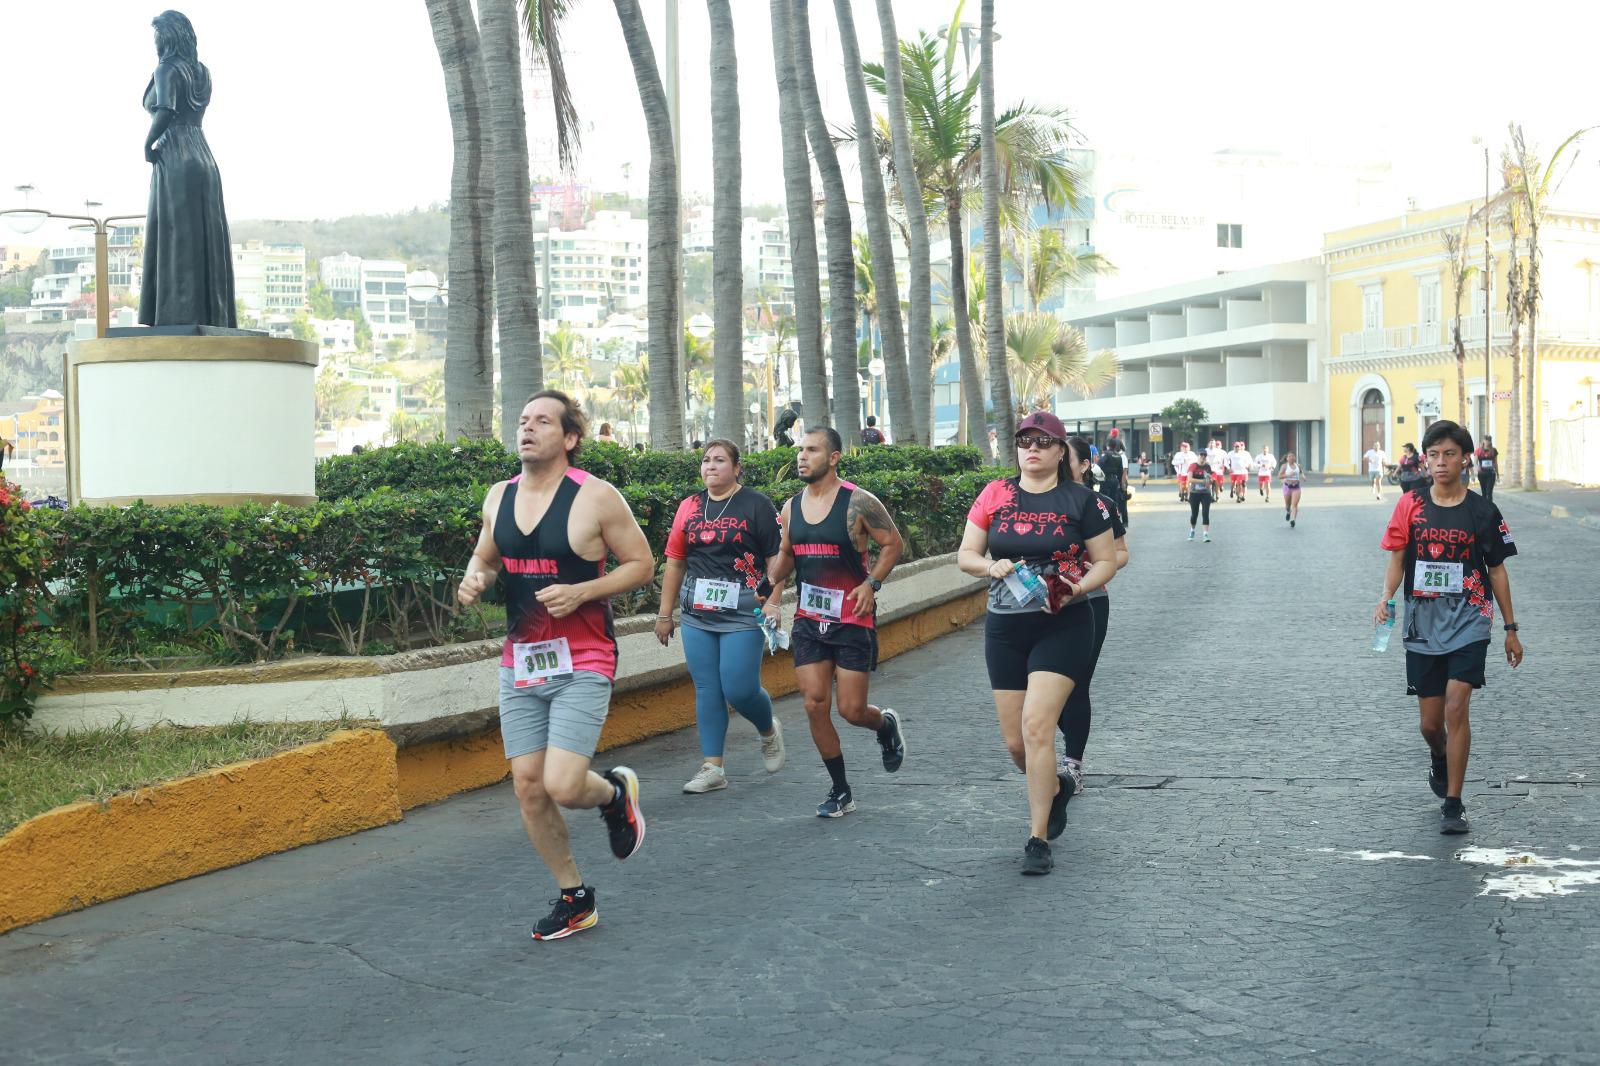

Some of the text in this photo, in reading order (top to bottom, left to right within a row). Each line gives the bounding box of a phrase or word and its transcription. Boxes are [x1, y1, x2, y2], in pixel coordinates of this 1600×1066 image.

[1000, 509, 1070, 523] CARRERA
[688, 517, 748, 531] CARRERA
[1414, 528, 1476, 544] CARRERA
[1424, 571, 1449, 587] 251
[706, 588, 728, 603] 217
[525, 651, 559, 673] 300
